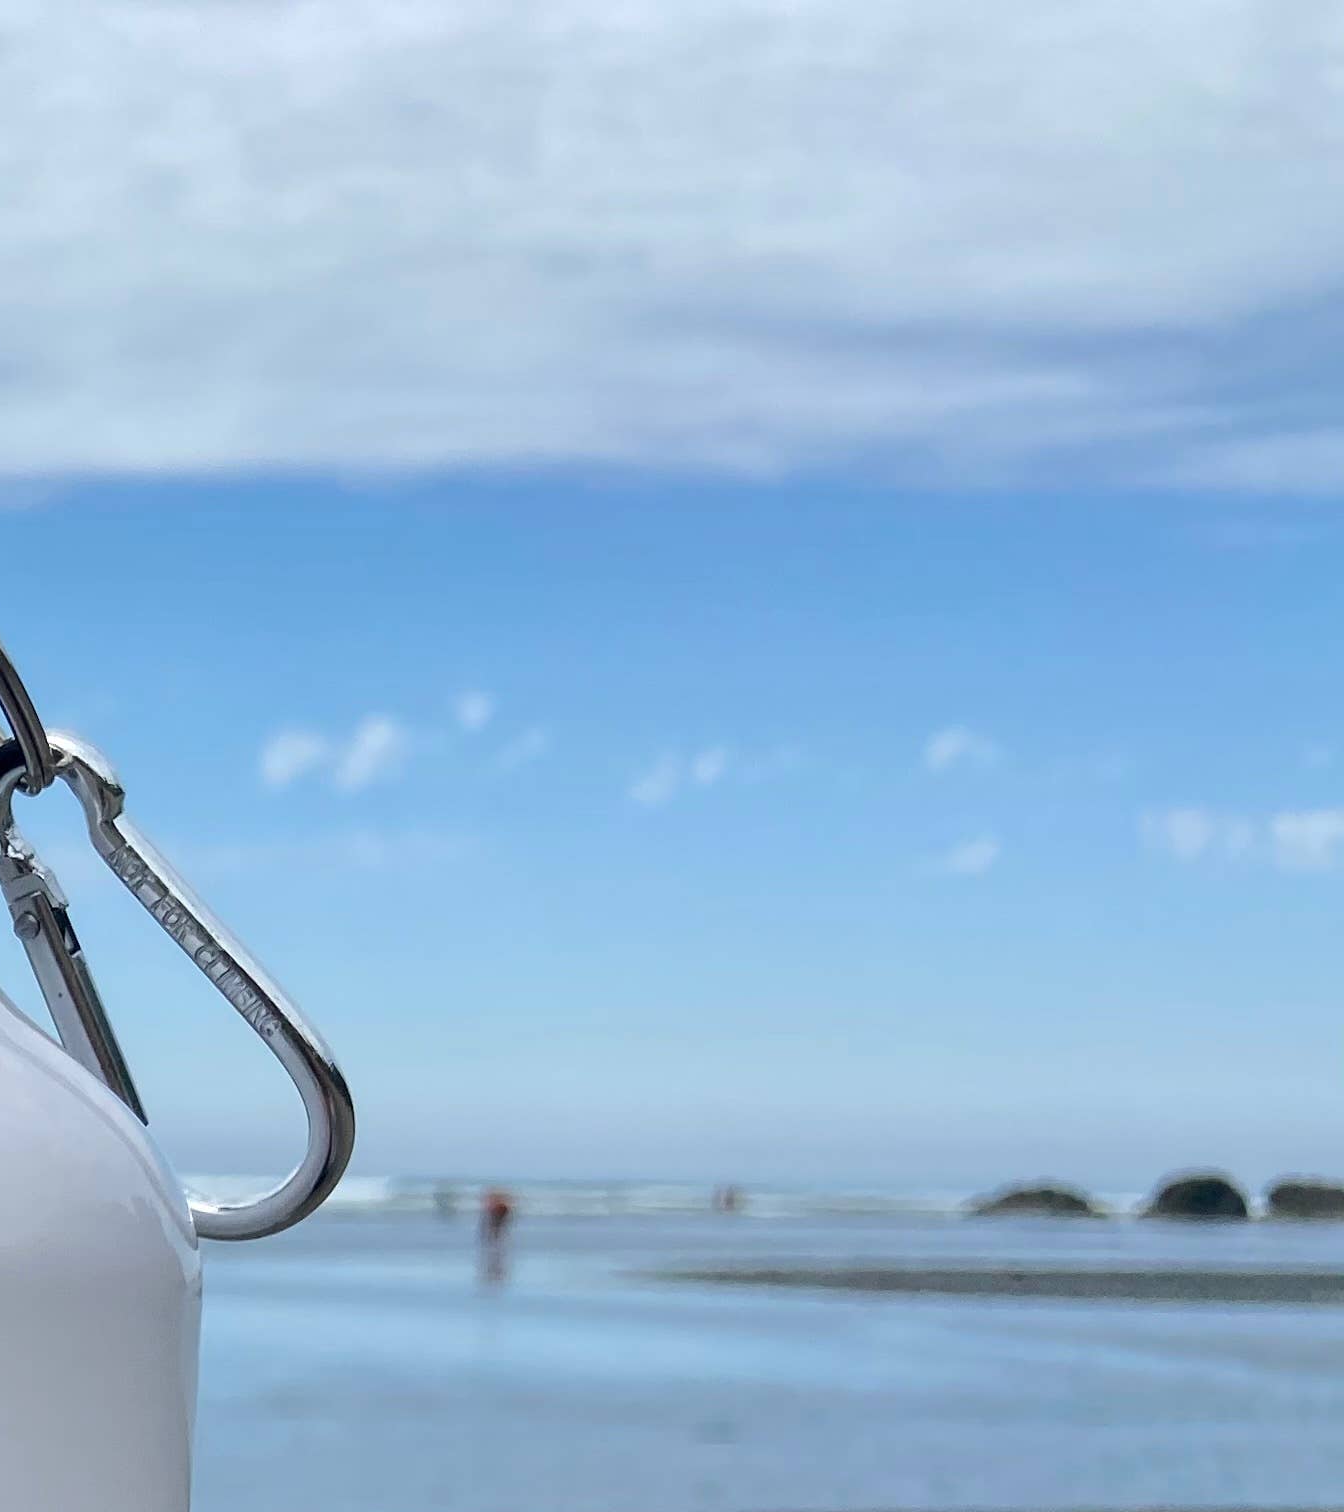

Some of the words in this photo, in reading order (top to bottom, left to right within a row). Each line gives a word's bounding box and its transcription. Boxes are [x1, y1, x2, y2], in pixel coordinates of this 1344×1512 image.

[109, 848, 157, 891] NOT
[150, 893, 195, 941] FOR
[194, 945, 282, 1037] CLIMBING
